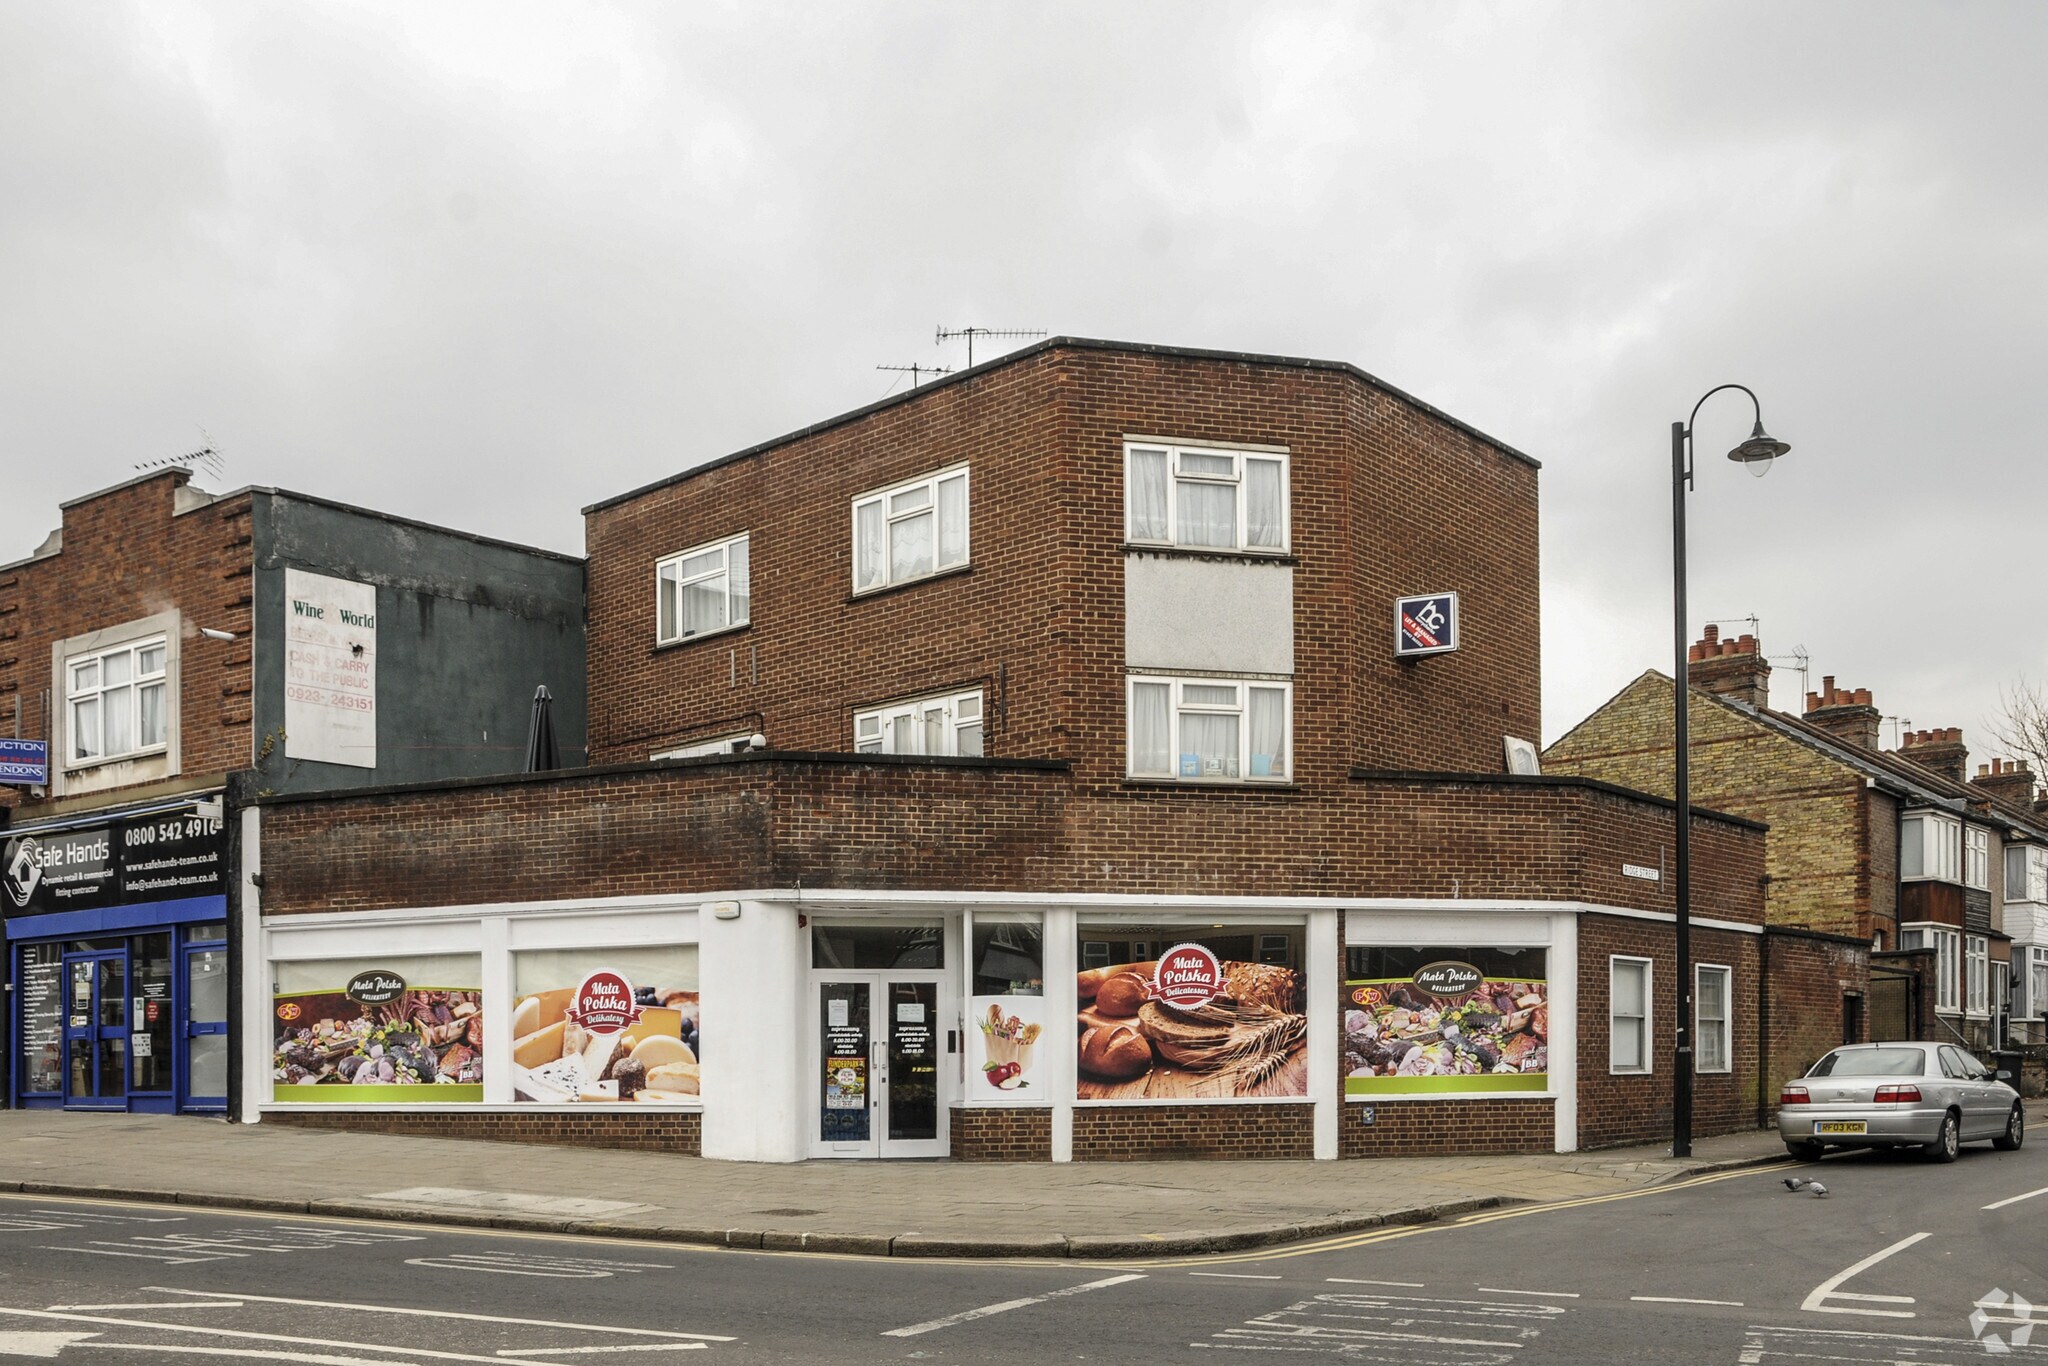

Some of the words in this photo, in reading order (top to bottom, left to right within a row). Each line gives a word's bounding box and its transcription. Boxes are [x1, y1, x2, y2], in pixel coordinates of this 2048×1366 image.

[293, 599, 324, 619] Wine
[339, 608, 374, 629] World
[1404, 616, 1413, 625] LET
[1415, 626, 1438, 646] MANAGED
[290, 650, 320, 665] CASH
[335, 658, 369, 673] CARRY
[290, 665, 304, 679] TO
[310, 669, 330, 683] THE
[333, 673, 369, 689] PUBLIC
[331, 694, 373, 710] 243151
[125, 826, 156, 847] 0800
[159, 821, 183, 842] 542
[35, 845, 63, 868] Safe
[66, 838, 109, 865] Hands
[125, 851, 218, 872] www.safehands-team.co.uk
[41, 874, 63, 887] Dynamic
[64, 872, 78, 882] retail
[79, 871, 84, 881] &
[84, 868, 114, 880] commercial
[125, 871, 218, 891] info@safehands-team.co.uk
[1640, 867, 1657, 879] STREET
[55, 887, 71, 898] fitting
[72, 885, 99, 895] contractor
[1164, 969, 1212, 985] Polska
[1446, 968, 1478, 983] Polska
[374, 976, 402, 992] Polska
[1165, 987, 1208, 997] Delicatessen
[1431, 983, 1466, 992] DELIKATESY
[583, 996, 627, 1011] Polska
[1355, 988, 1379, 1005] PSW
[586, 1014, 624, 1026] Delikatesy
[1520, 1059, 1538, 1073] JBB
[459, 1070, 473, 1083] JBB
[1822, 1123, 1844, 1132] RF03
[1846, 1123, 1864, 1132] KGN
